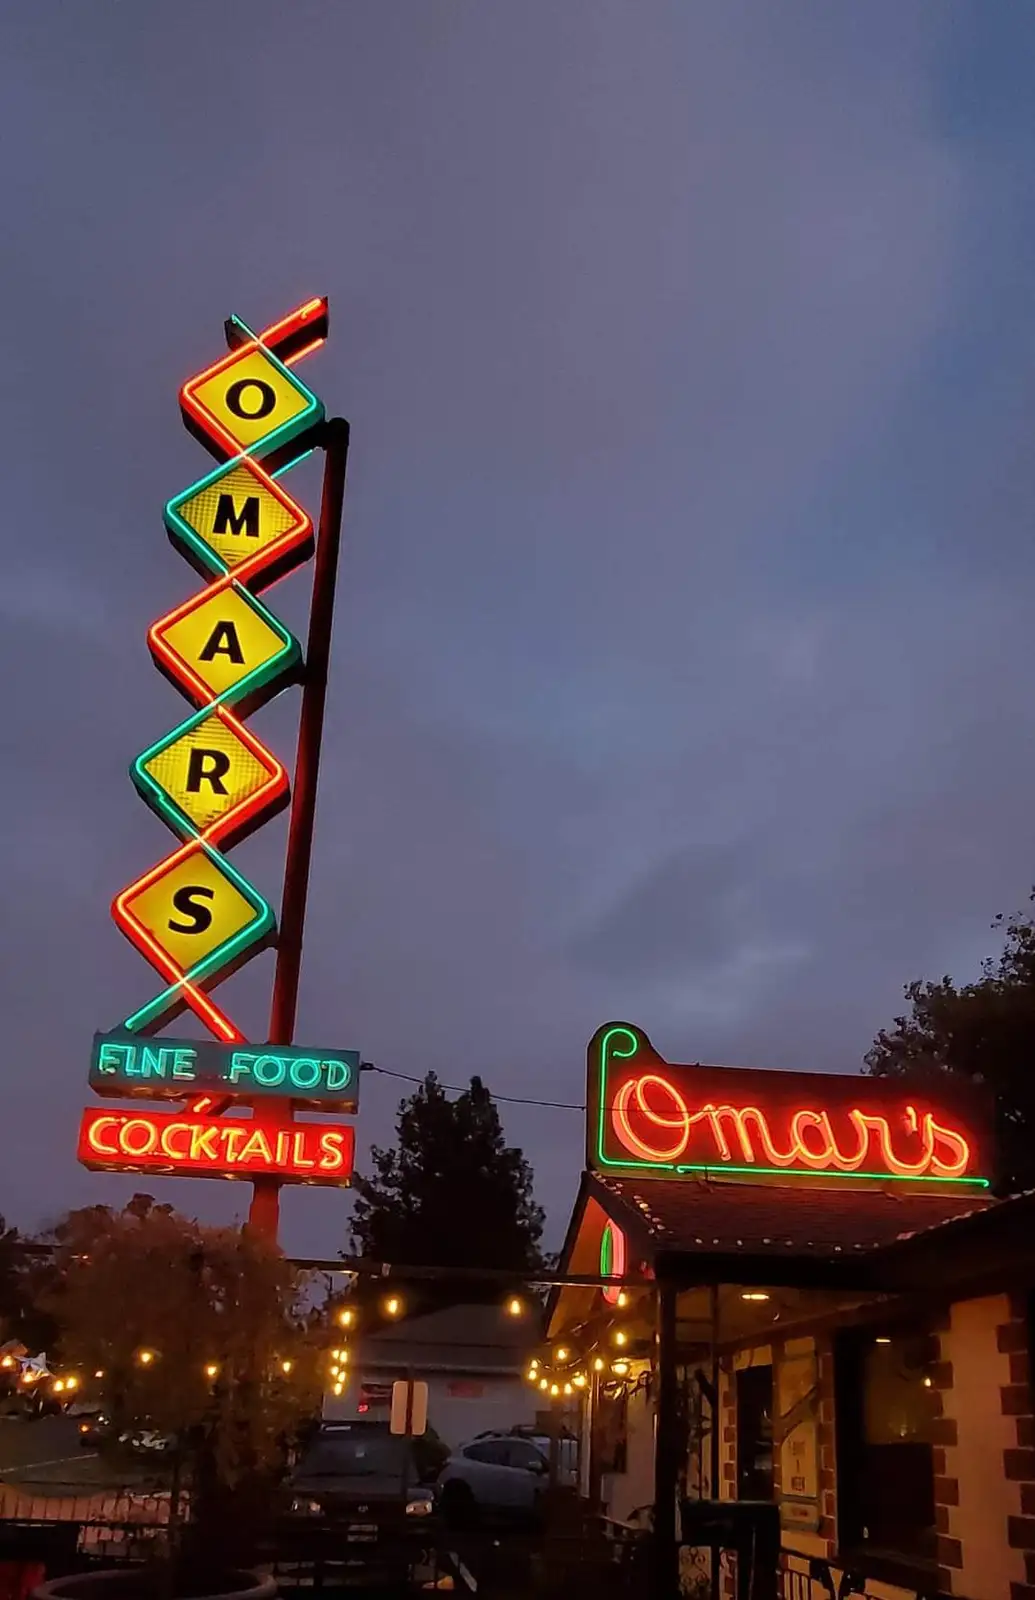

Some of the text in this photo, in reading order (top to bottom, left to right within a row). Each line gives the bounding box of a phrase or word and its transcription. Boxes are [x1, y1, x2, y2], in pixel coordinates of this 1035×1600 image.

[167, 378, 276, 935] OMARS
[99, 1043, 351, 1091] FINE FOOD
[88, 1116, 345, 1170] COCKTAILS
[611, 1074, 970, 1177] Omar's
